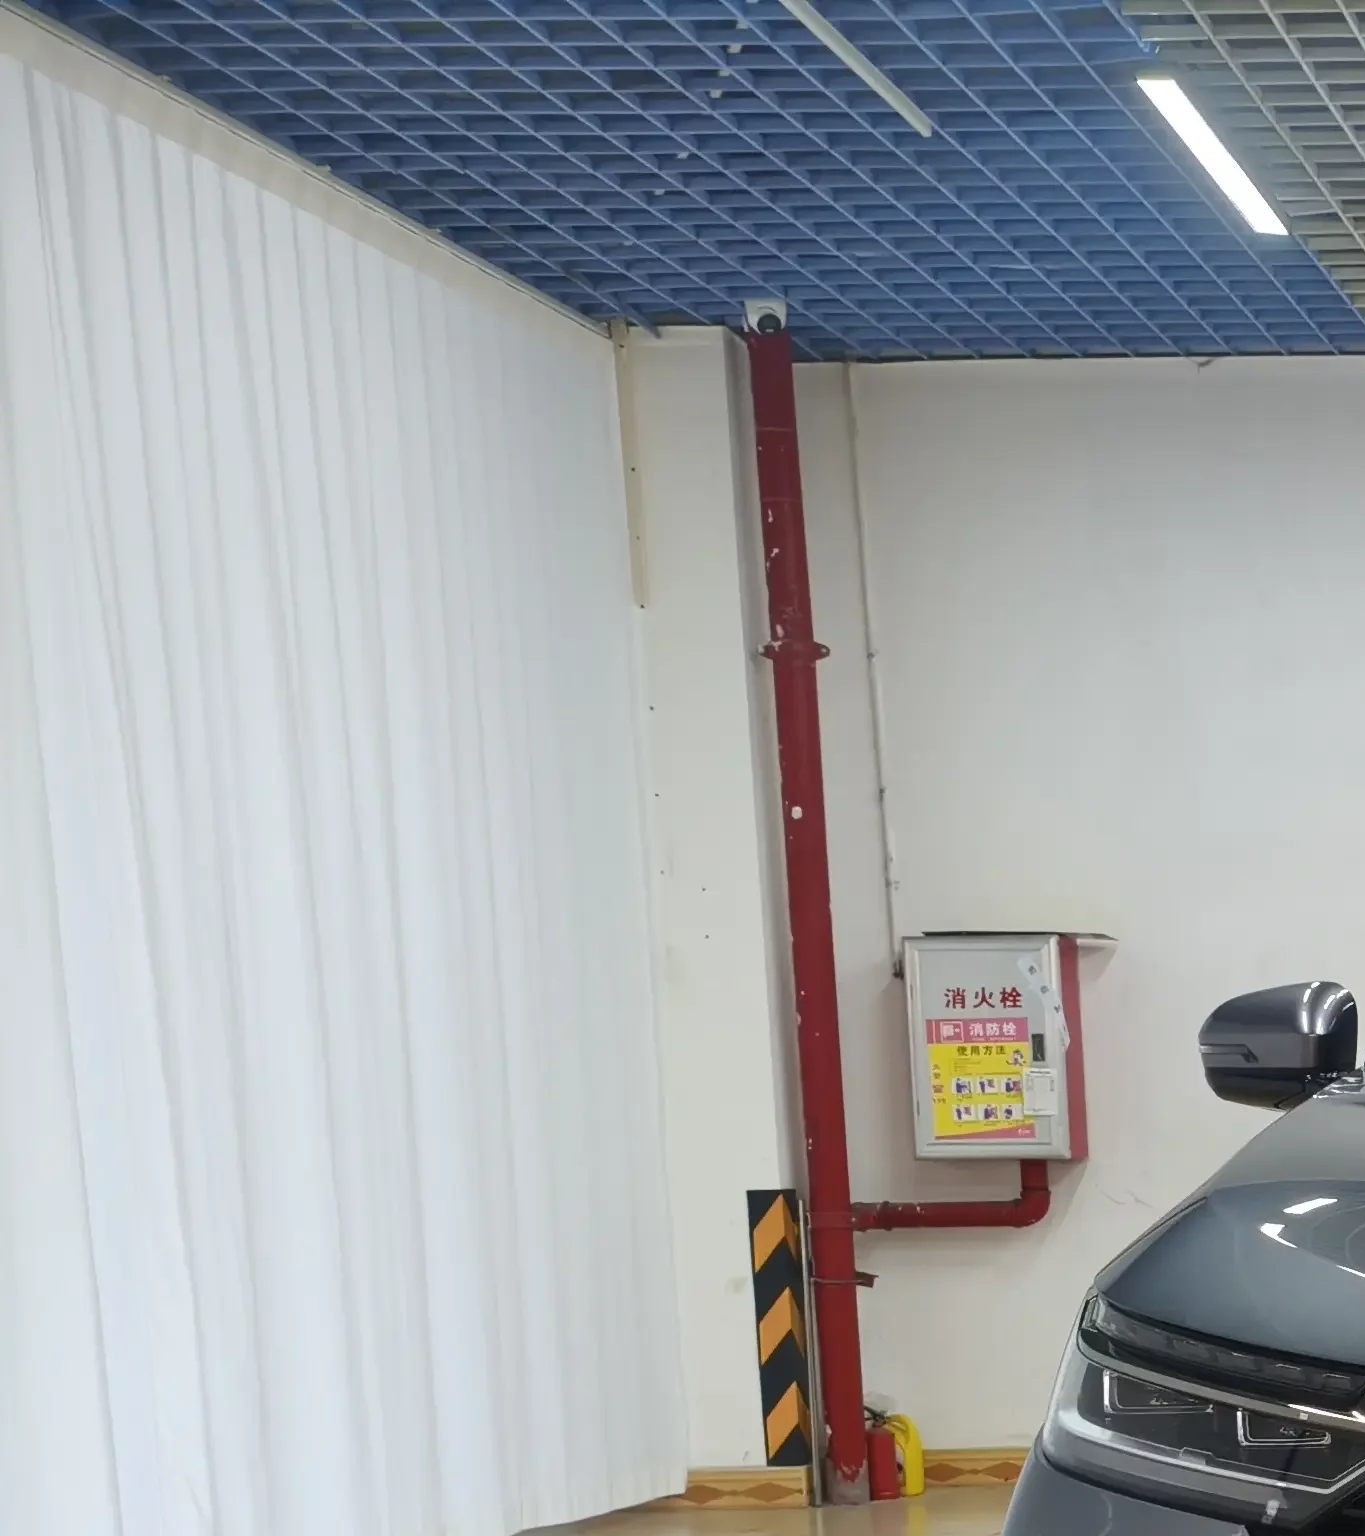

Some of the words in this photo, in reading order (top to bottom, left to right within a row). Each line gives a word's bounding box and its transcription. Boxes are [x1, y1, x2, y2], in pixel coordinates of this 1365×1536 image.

[943, 986, 1023, 1009] 消火栓
[968, 1021, 1017, 1038] 消防栓
